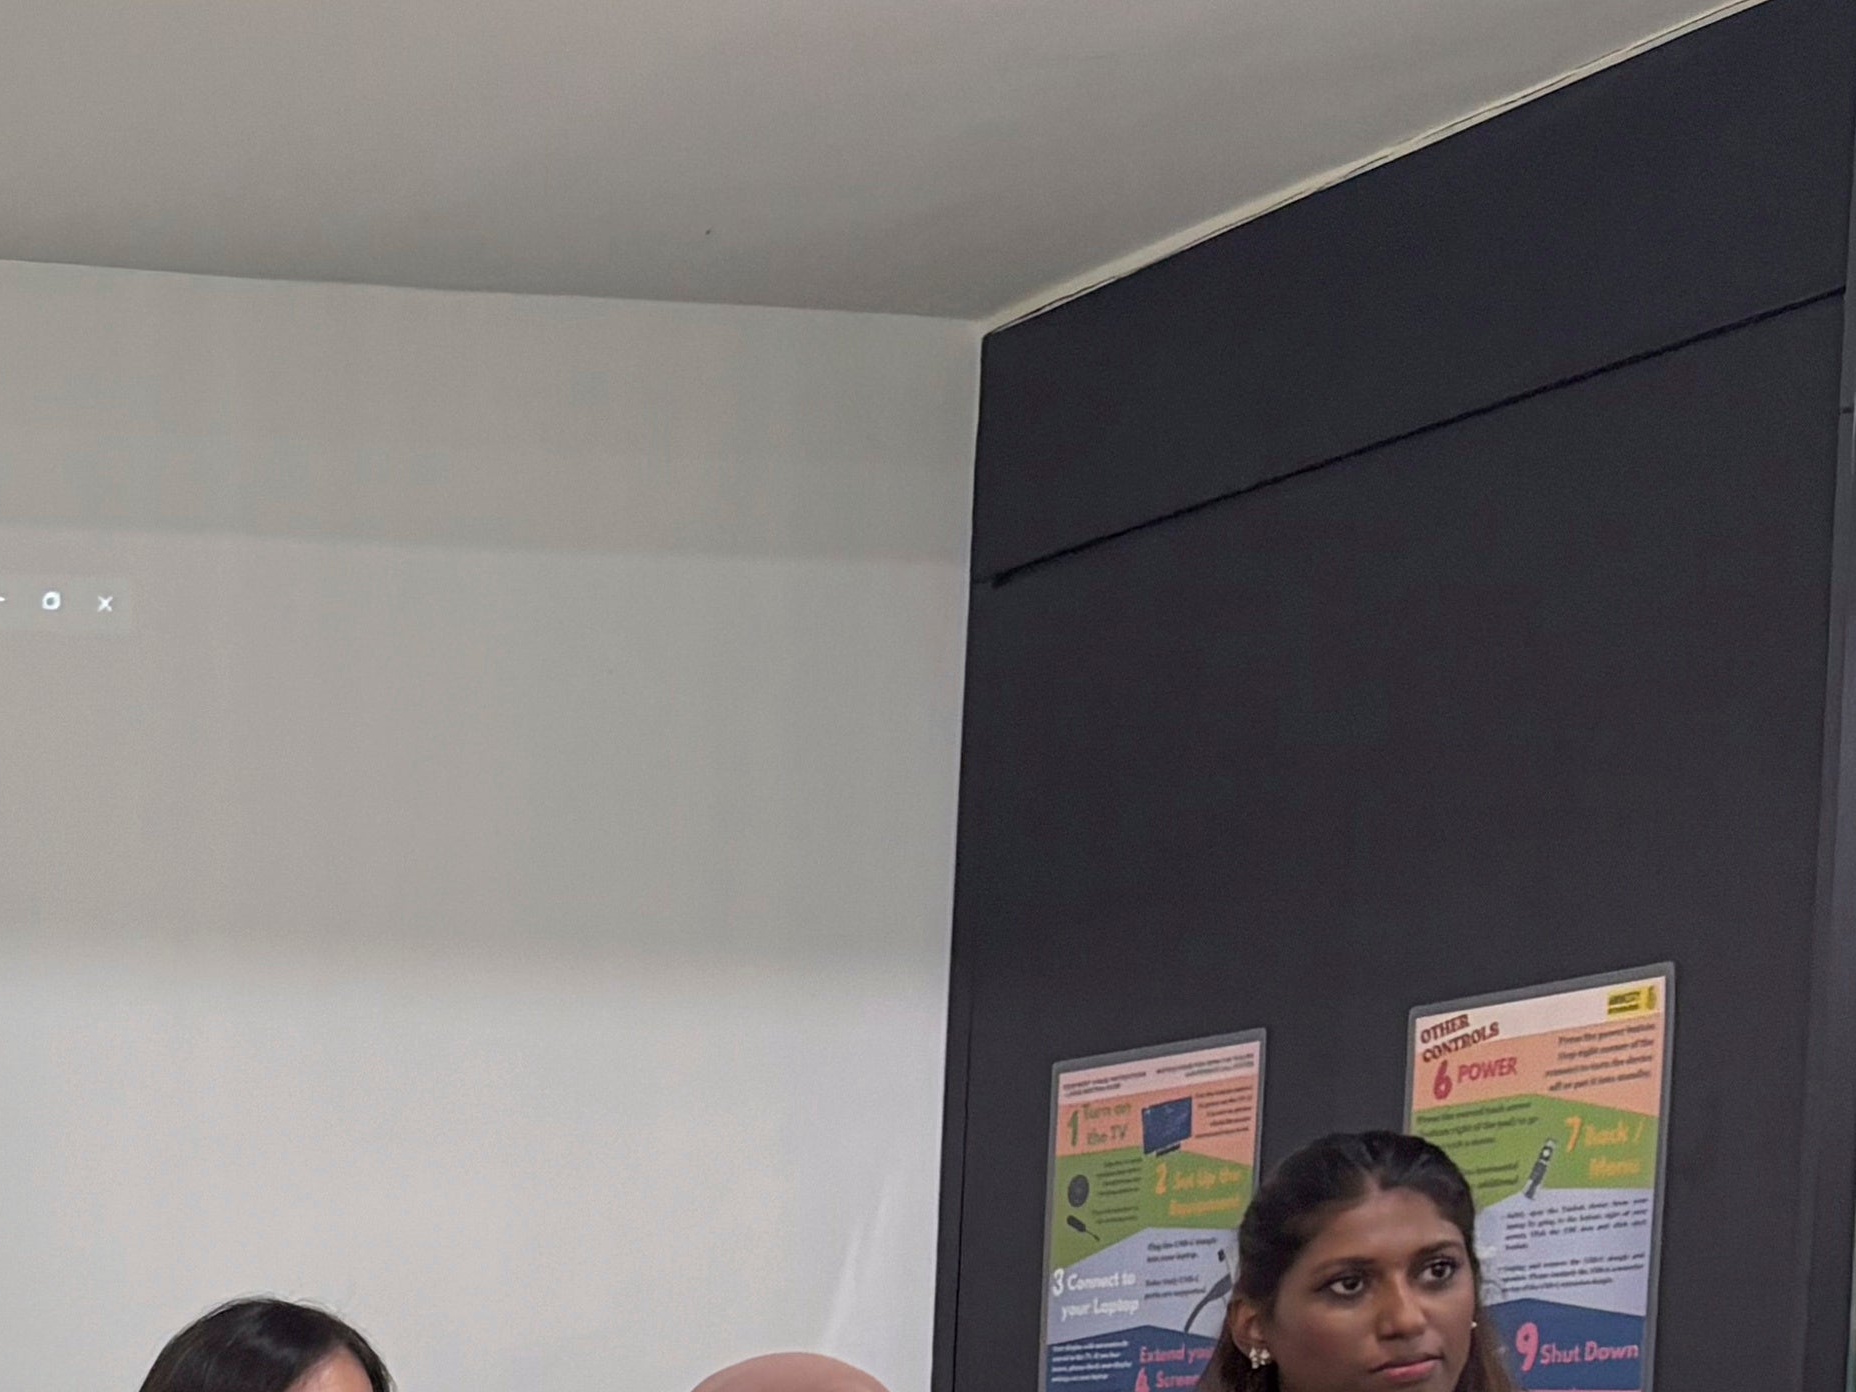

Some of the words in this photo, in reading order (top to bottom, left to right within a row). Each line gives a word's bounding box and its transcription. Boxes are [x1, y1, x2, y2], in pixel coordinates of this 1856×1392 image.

[1420, 1014, 1470, 1044] OTHER
[1422, 1022, 1500, 1063] CONTROLS
[1433, 1059, 1452, 1100] 6
[1457, 1057, 1518, 1084] POWER
[1067, 1109, 1080, 1147] 1
[1082, 1102, 1111, 1120] Turn
[1113, 1103, 1132, 1116] on
[1087, 1129, 1108, 1146] the
[1111, 1124, 1129, 1140] TV
[1565, 1115, 1583, 1153] 7
[1155, 1161, 1169, 1197] 2
[1052, 1267, 1065, 1297] 3
[1067, 1271, 1119, 1293] Connect
[1121, 1270, 1137, 1287] to
[1061, 1302, 1090, 1323] your
[1092, 1296, 1140, 1317] Laptop
[1140, 1343, 1187, 1363] Extend
[1515, 1321, 1539, 1373] 9
[1540, 1342, 1581, 1365] Shut
[1584, 1340, 1640, 1362] Down
